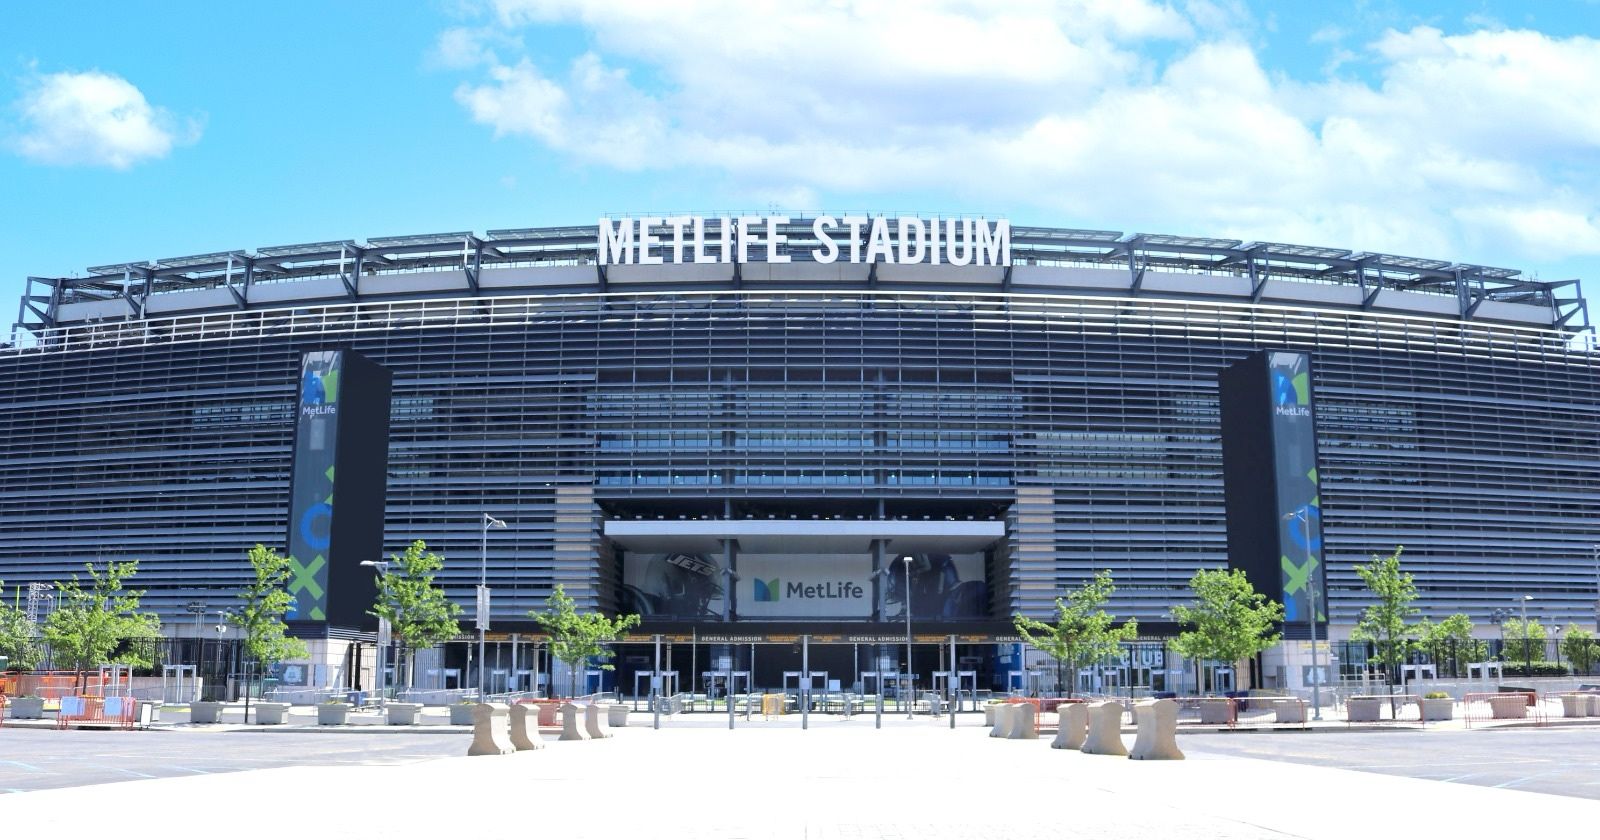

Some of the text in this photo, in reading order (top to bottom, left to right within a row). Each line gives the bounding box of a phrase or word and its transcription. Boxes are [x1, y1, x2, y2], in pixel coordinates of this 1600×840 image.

[598, 215, 1011, 266] METLIFE STADIUM
[302, 405, 336, 415] MetLife
[1276, 406, 1310, 417] MetLife
[786, 582, 863, 599] MetLife
[1119, 650, 1164, 669] CLUB
